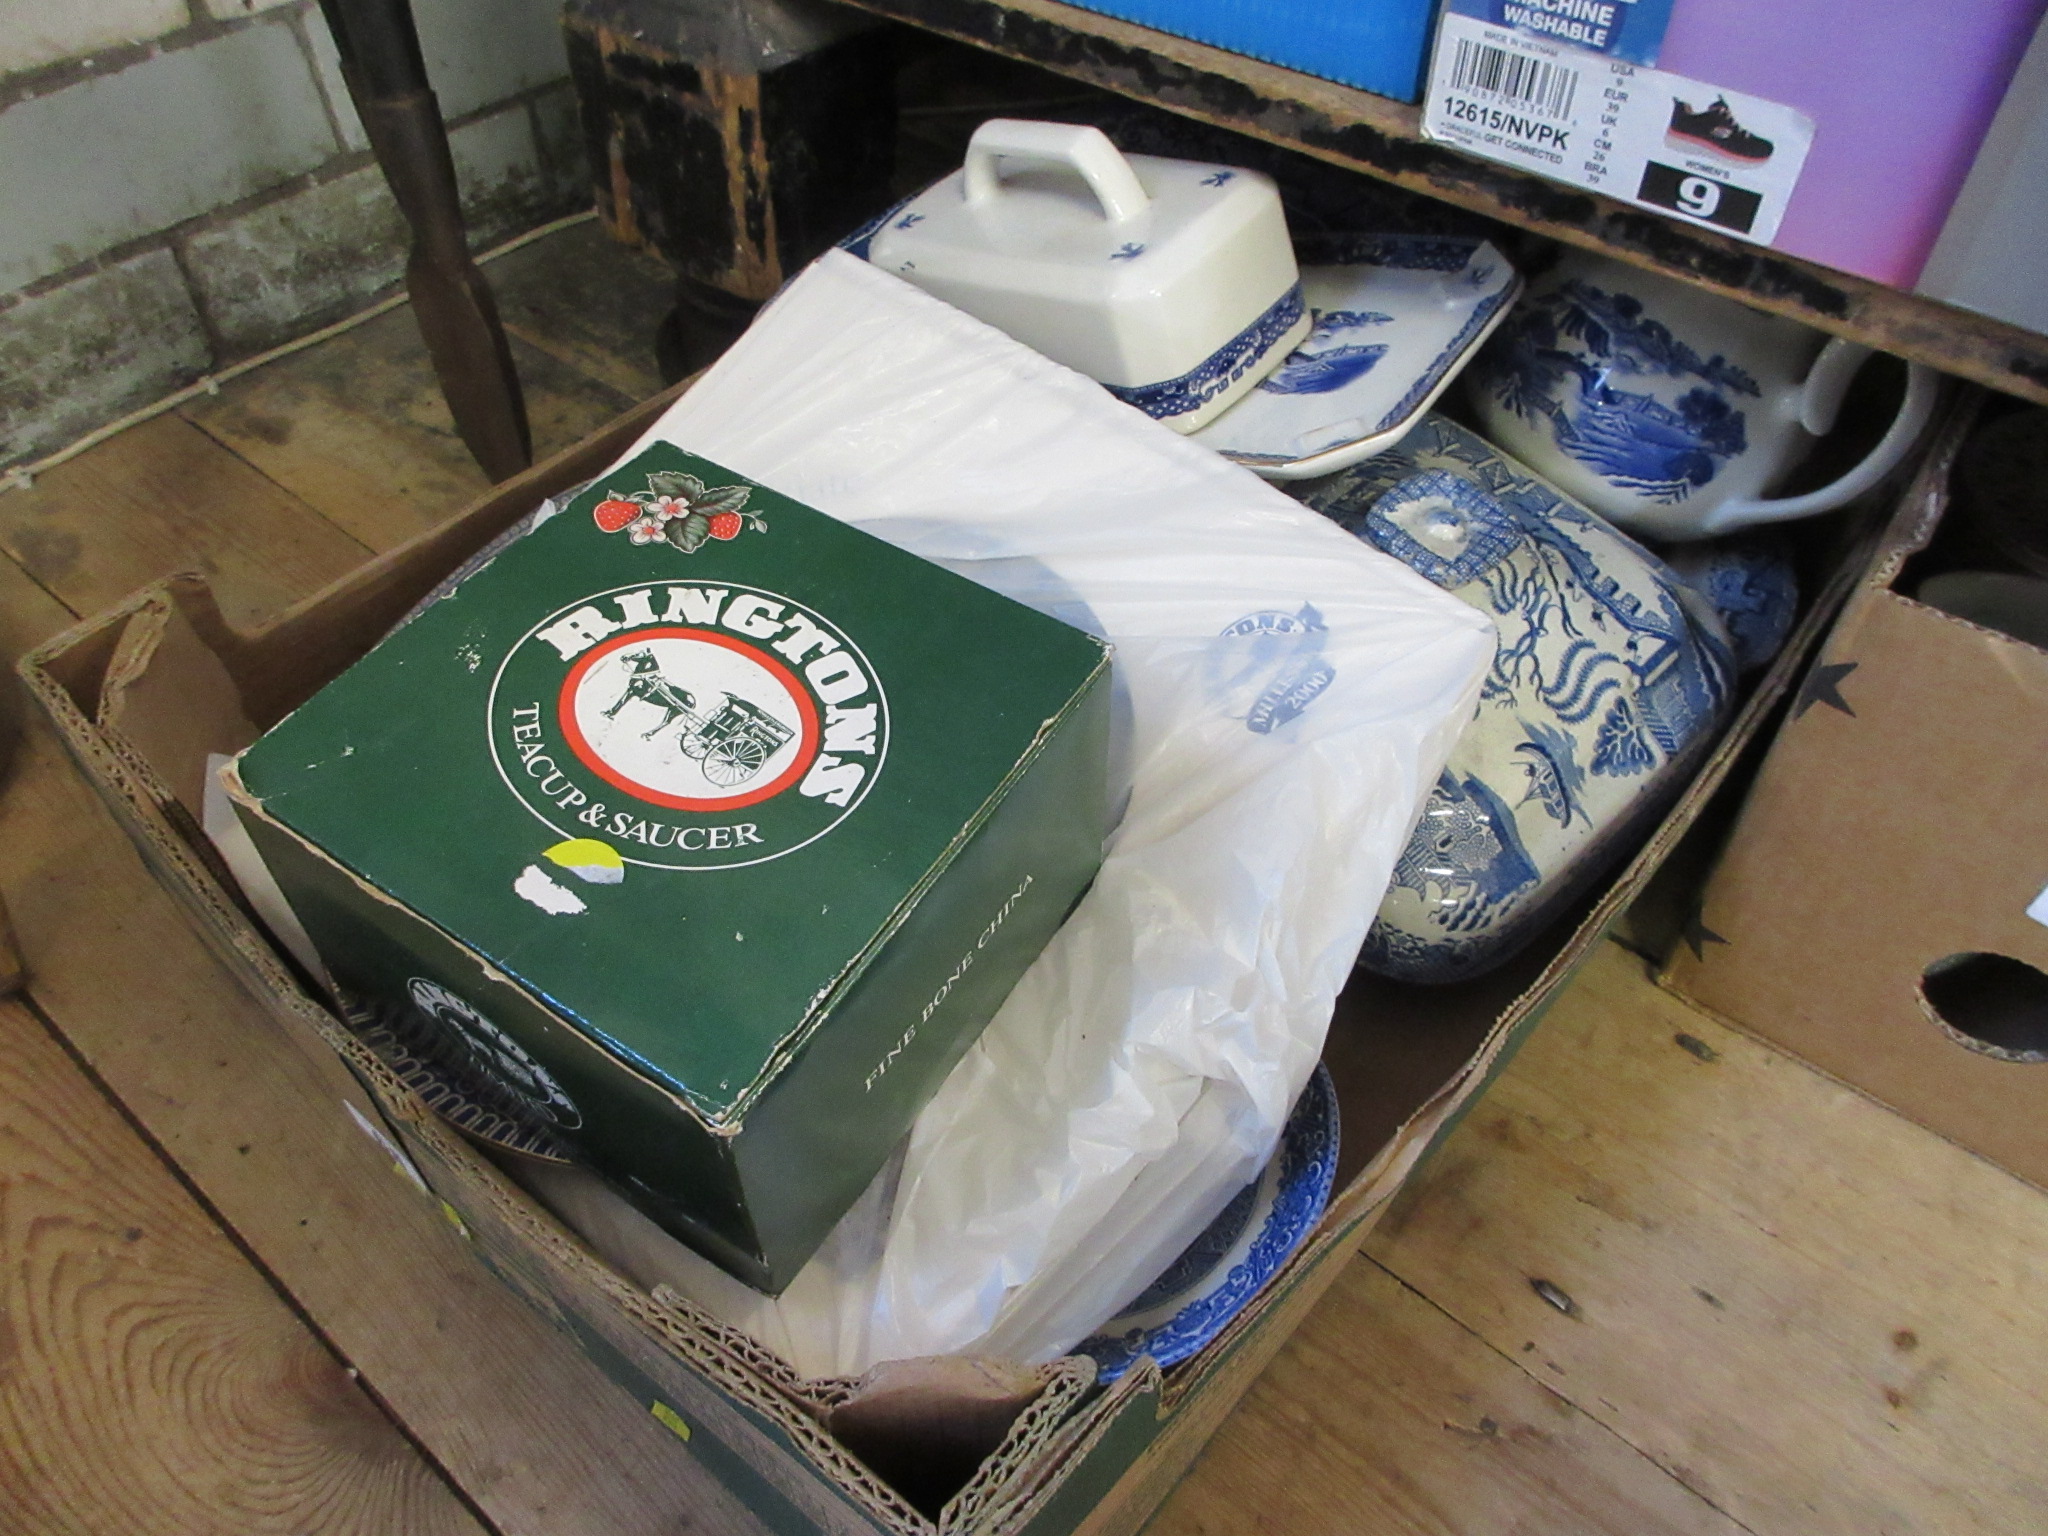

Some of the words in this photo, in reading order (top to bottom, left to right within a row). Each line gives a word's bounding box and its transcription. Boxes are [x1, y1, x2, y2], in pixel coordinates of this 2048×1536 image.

[1516, 0, 1616, 27] CHINE
[1503, 4, 1608, 48] WASHABLE
[1610, 63, 1635, 77] USA
[1604, 87, 1629, 102] EUR
[1606, 102, 1620, 113] 39
[1444, 96, 1570, 151] 12615/NVPK
[1601, 115, 1618, 127] UK
[1602, 128, 1609, 137] 6
[1484, 133, 1503, 146] GET
[1505, 140, 1563, 165] CONNECTED
[1594, 139, 1613, 151] CM
[1592, 151, 1606, 162] 26
[1584, 161, 1608, 176] BRA
[1685, 160, 1730, 179] WOMEN'S
[1586, 174, 1600, 184] 39
[1676, 176, 1721, 218] 9
[536, 587, 878, 808] RINGTONS
[1285, 670, 1329, 709] 2000
[511, 701, 587, 812] TEACUP
[579, 803, 606, 829] &
[605, 812, 765, 852] SAUCER
[864, 1024, 917, 1093] FINE
[922, 950, 974, 1024] BONE
[977, 874, 1034, 949] CHINA
